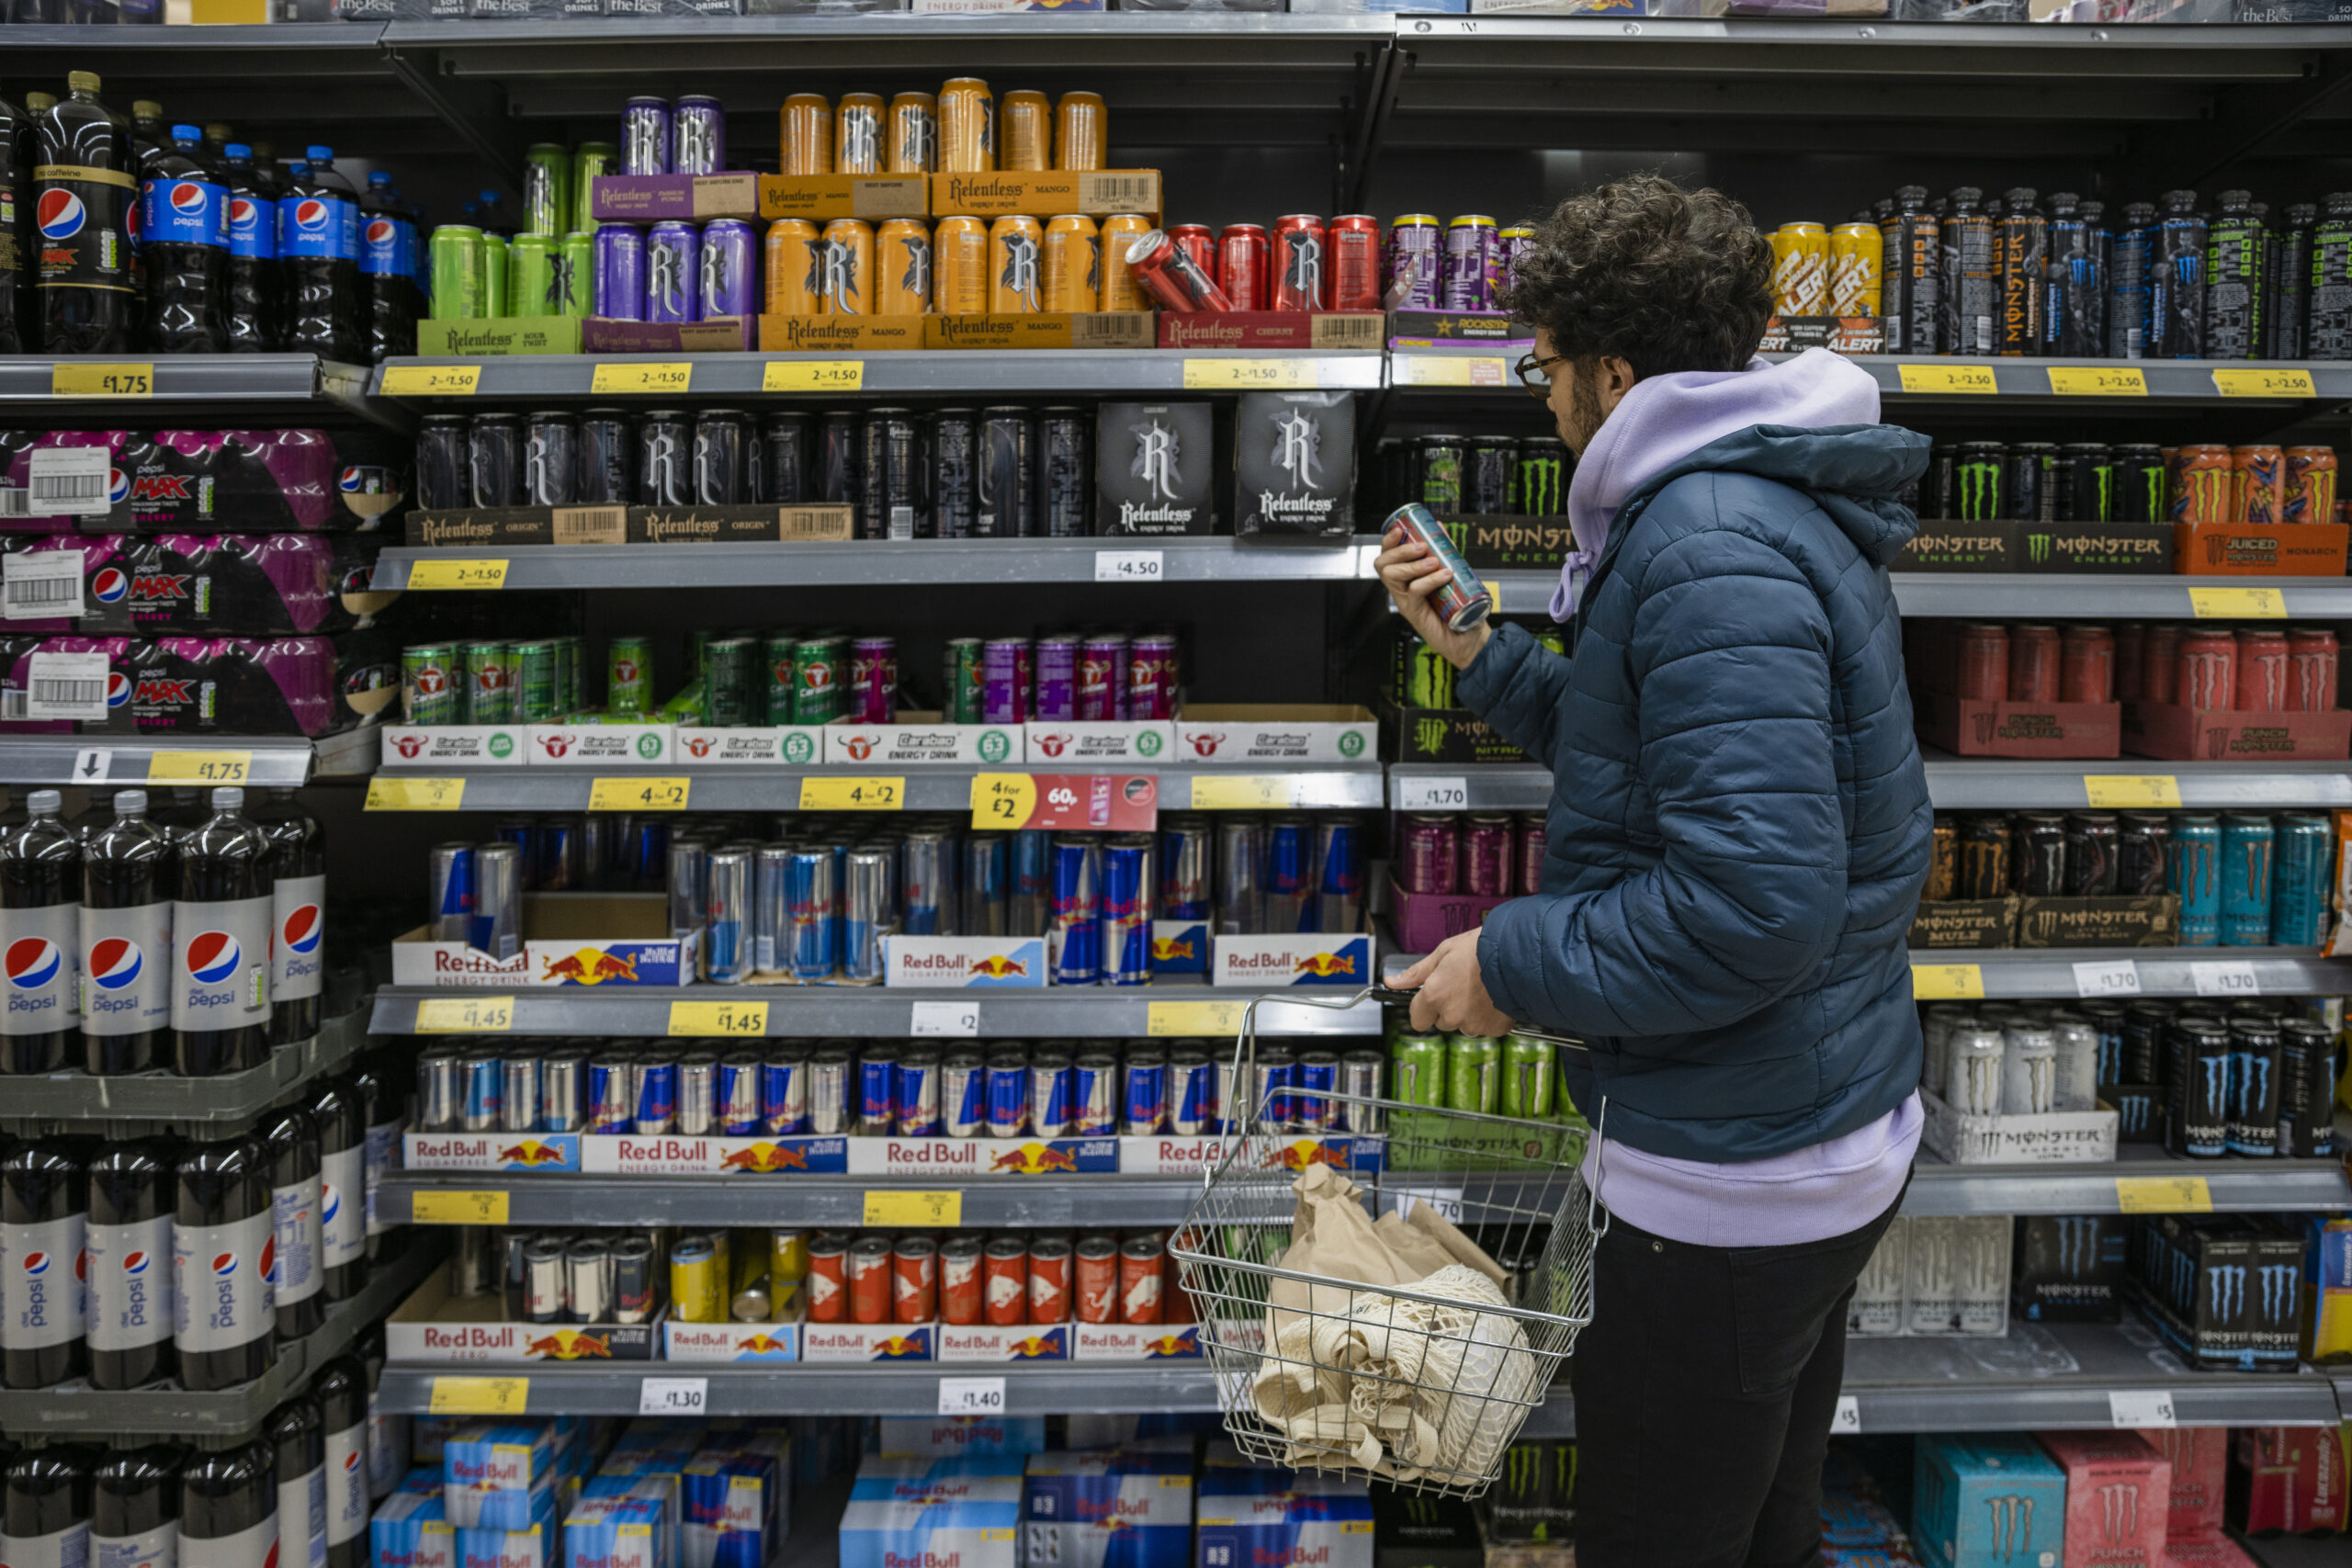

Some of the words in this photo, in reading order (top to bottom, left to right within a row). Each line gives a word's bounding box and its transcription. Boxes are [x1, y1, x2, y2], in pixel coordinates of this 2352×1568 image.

[565, 4, 599, 12] DRINKS
[927, 2, 972, 11] ENERGY
[976, 2, 1003, 11] DRINK
[2243, 8, 2263, 22] the
[2266, 8, 2293, 22] Best
[47, 169, 81, 177] caffeine
[949, 177, 1023, 208] Relentless
[1035, 185, 1070, 193] MANGO
[601, 186, 653, 208] Relentless
[173, 217, 203, 227] pepsi
[298, 233, 325, 243] pepsi
[2005, 234, 2025, 342] MONSTER
[786, 317, 861, 348] Relentless
[871, 328, 906, 336] MANGO
[940, 315, 1015, 344] Relentless
[447, 327, 514, 350] Relentless
[523, 339, 548, 347] TWIST
[1758, 338, 1790, 352] ERT
[1827, 337, 1883, 352] ALERT
[642, 373, 650, 383] 2
[658, 372, 685, 383] £1.50
[812, 370, 820, 380] 2
[830, 369, 857, 380] £1.50
[1249, 367, 1277, 378] £1.50
[1962, 374, 1990, 384] £2.50
[103, 375, 148, 393] £1.75
[430, 376, 438, 386] 2
[447, 375, 473, 385] £1.50
[2112, 377, 2141, 387] £2.50
[2278, 378, 2307, 389] £2.50
[137, 464, 164, 474] pepsi
[130, 475, 195, 500] MAX
[1260, 488, 1333, 523] Relentless
[1119, 500, 1192, 533] Relentless
[422, 516, 498, 547] Relentless
[505, 522, 540, 531] ORIGIN
[645, 512, 721, 542] Relentless
[732, 521, 766, 529] ORIGIN
[1477, 525, 1573, 551] MONST
[2056, 535, 2162, 555] MONSTER
[2226, 537, 2278, 550] JUICED
[1919, 555, 1986, 563] ENERGY
[2286, 547, 2337, 556] MONARCH
[2075, 556, 2143, 564] ENERGY
[135, 563, 162, 574] pepsi
[458, 569, 466, 580] 2
[474, 569, 501, 580] £1.50
[1117, 561, 1159, 578] £4.50
[129, 574, 192, 599] MAX
[129, 613, 172, 621] CHERRY
[139, 667, 166, 678] pepsi
[131, 679, 197, 704] MAX
[641, 738, 659, 751] 63
[727, 738, 774, 750] Carabao
[787, 740, 808, 754] 63
[897, 733, 956, 748] Carabao
[982, 739, 1005, 753] 63
[1140, 737, 1157, 749] 63
[1342, 737, 1361, 750] 63
[577, 749, 606, 757] ENERGY
[888, 751, 928, 761] ENERGY
[931, 751, 958, 760] DRINK
[1248, 748, 1281, 757] ENERGY
[1283, 748, 1308, 756] DRINK
[199, 762, 243, 780] £1.75
[640, 787, 652, 802] 4
[666, 786, 683, 802] £2
[851, 786, 862, 802] 4
[877, 786, 894, 802] £2
[992, 782, 1001, 794] 4
[1003, 786, 1020, 795] for
[1047, 788, 1078, 806] 60p
[1428, 790, 1464, 804] £1.70
[992, 799, 1014, 818] £2
[1915, 915, 1996, 931] MONSTER
[2061, 910, 2149, 926] MONSTER
[903, 954, 933, 969] Red
[934, 954, 966, 969] Bull
[1228, 954, 1259, 968] Red
[1261, 953, 1291, 968] Bull
[435, 976, 485, 986] ENERGY
[491, 976, 529, 986] DRINK
[2100, 975, 2135, 988] £1.70
[2219, 976, 2254, 989] £1.70
[7, 995, 57, 1014] pepsi
[93, 998, 139, 1013] pepsi
[188, 990, 234, 1009] pepsi
[464, 1009, 506, 1027] £1.45
[718, 1013, 762, 1032] £1.45
[962, 1014, 976, 1030] £2
[2006, 1130, 2100, 1145] MONSTER
[416, 1141, 450, 1158] Red
[453, 1141, 487, 1157] Bull
[618, 1140, 660, 1161] Red
[662, 1140, 707, 1160] Bull
[888, 1142, 931, 1164] Red
[934, 1142, 977, 1163] Bull
[30, 1279, 48, 1327] pepsi
[130, 1279, 147, 1327] pepsi
[219, 1279, 236, 1329] pepsi
[424, 1327, 468, 1348] Red
[471, 1327, 514, 1347] Bull
[673, 1333, 700, 1346] Red
[702, 1333, 729, 1346] Bull
[808, 1335, 834, 1348] Red
[837, 1335, 865, 1348] Bull
[944, 1337, 971, 1349] Red
[974, 1336, 1001, 1348] Bull
[1080, 1335, 1107, 1348] Red
[1109, 1335, 1136, 1348] Bull
[450, 1350, 488, 1360] ZERO
[666, 1391, 702, 1407] £1.30
[964, 1391, 1001, 1407] £1.40
[2157, 1404, 2172, 1419] £5
[454, 1461, 483, 1479] Red
[1116, 1499, 1148, 1516] Bull
[885, 1551, 922, 1568] Red
[925, 1552, 960, 1568] Bull
[1295, 1547, 1329, 1564] Bull
